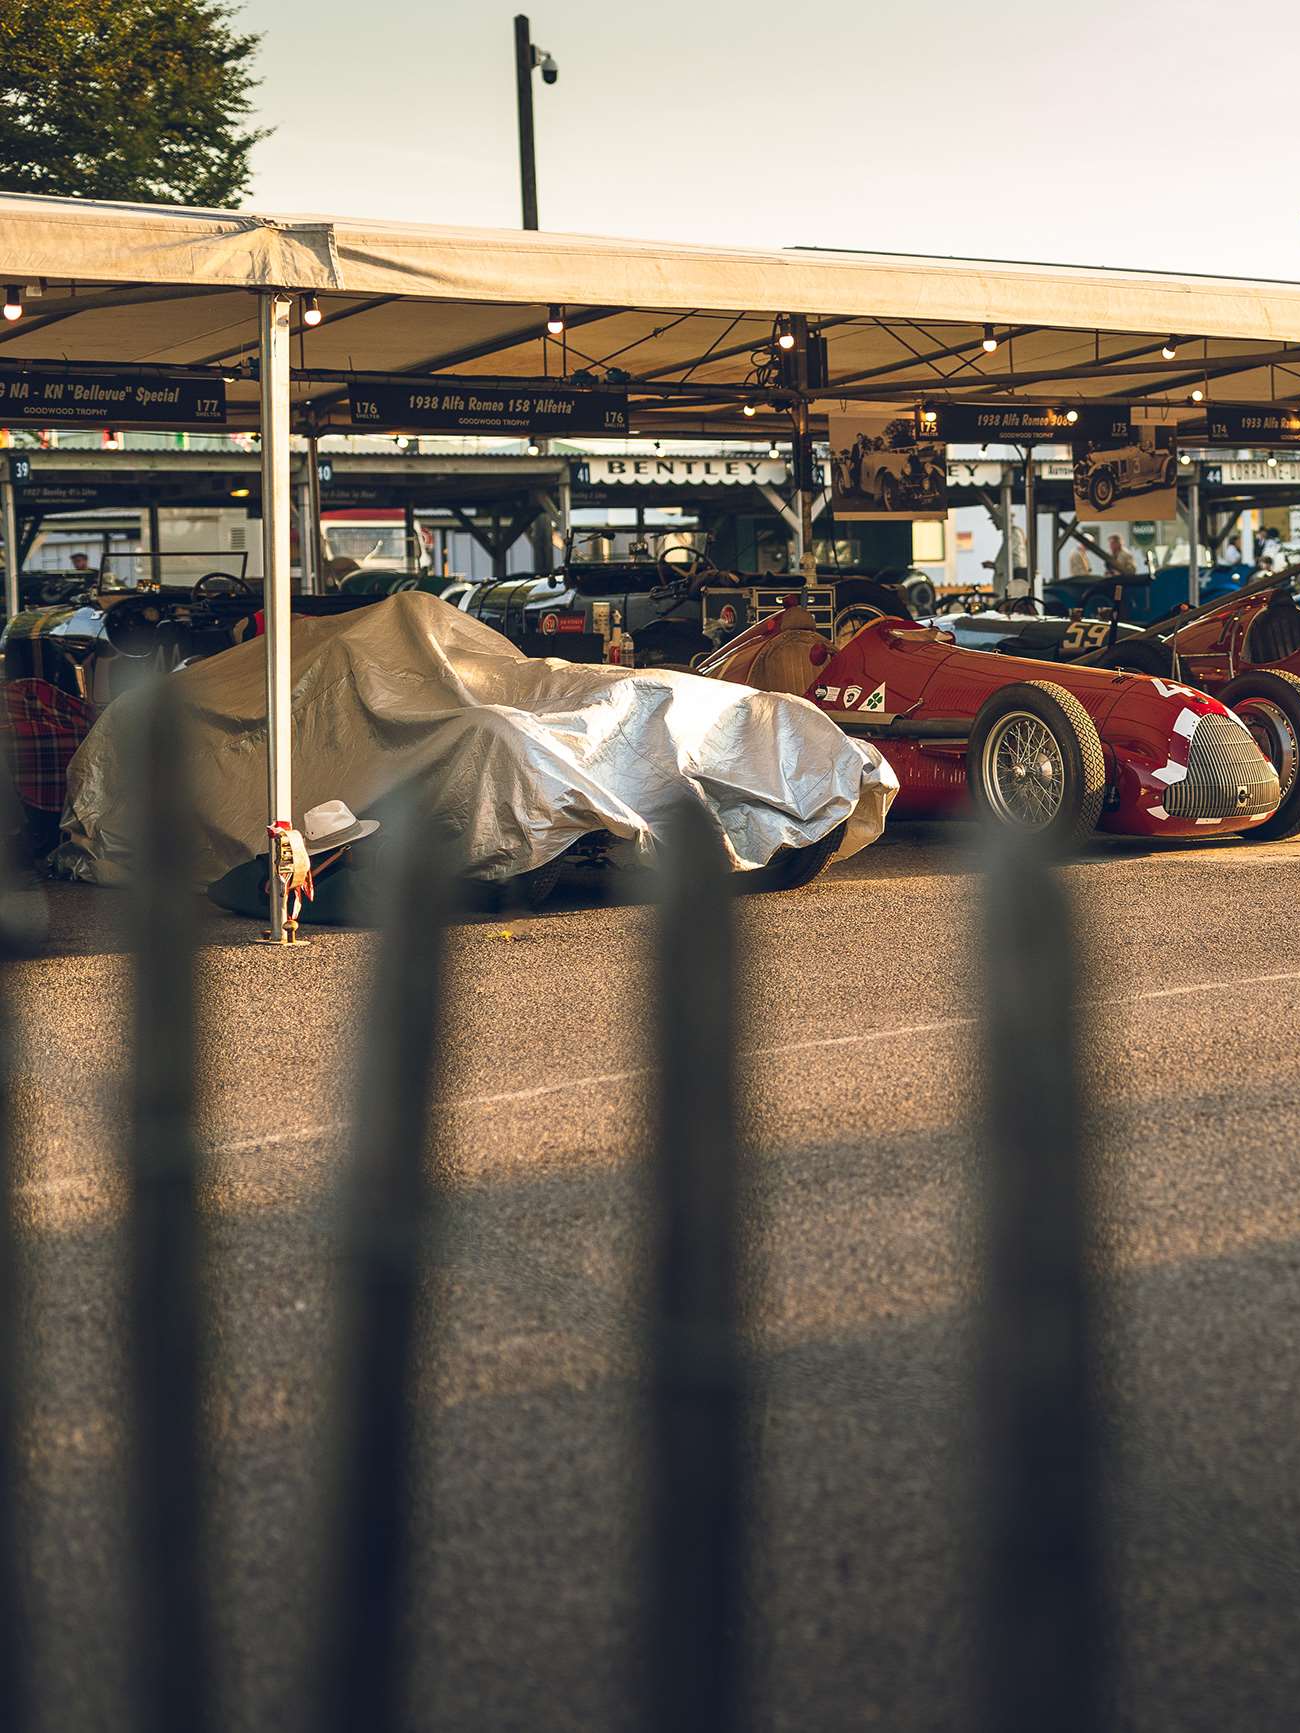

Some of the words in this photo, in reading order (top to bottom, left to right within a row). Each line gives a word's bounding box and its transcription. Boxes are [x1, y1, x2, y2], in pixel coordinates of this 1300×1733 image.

[9, 382, 29, 399] NA
[44, 383, 64, 400] KN
[67, 384, 132, 402] "Bellevue"
[136, 386, 180, 406] Special
[195, 399, 219, 412] 177
[356, 402, 379, 415] 176
[408, 395, 439, 410] 1938
[442, 396, 465, 411] Alfa
[468, 397, 504, 412] Romeo
[508, 399, 530, 414] 158
[24, 406, 74, 415] GOODWOOD
[75, 407, 108, 417] TROPHY
[604, 411, 625, 423] 176
[458, 417, 502, 426] GOODWOOD
[503, 418, 530, 427] TROPHY
[920, 420, 937, 432] 175
[977, 413, 1001, 427] 1938
[1002, 413, 1020, 427] Alfa
[1022, 414, 1049, 427] Romeo
[1241, 417, 1262, 430] 1933
[1111, 422, 1127, 433] 175
[1212, 423, 1228, 434] 174
[15, 462, 29, 478] 39
[576, 466, 589, 482] 41
[607, 460, 762, 476] BENTLEY
[1206, 469, 1221, 483] 44
[1062, 621, 1111, 649] 59
[1150, 678, 1196, 698] 4
